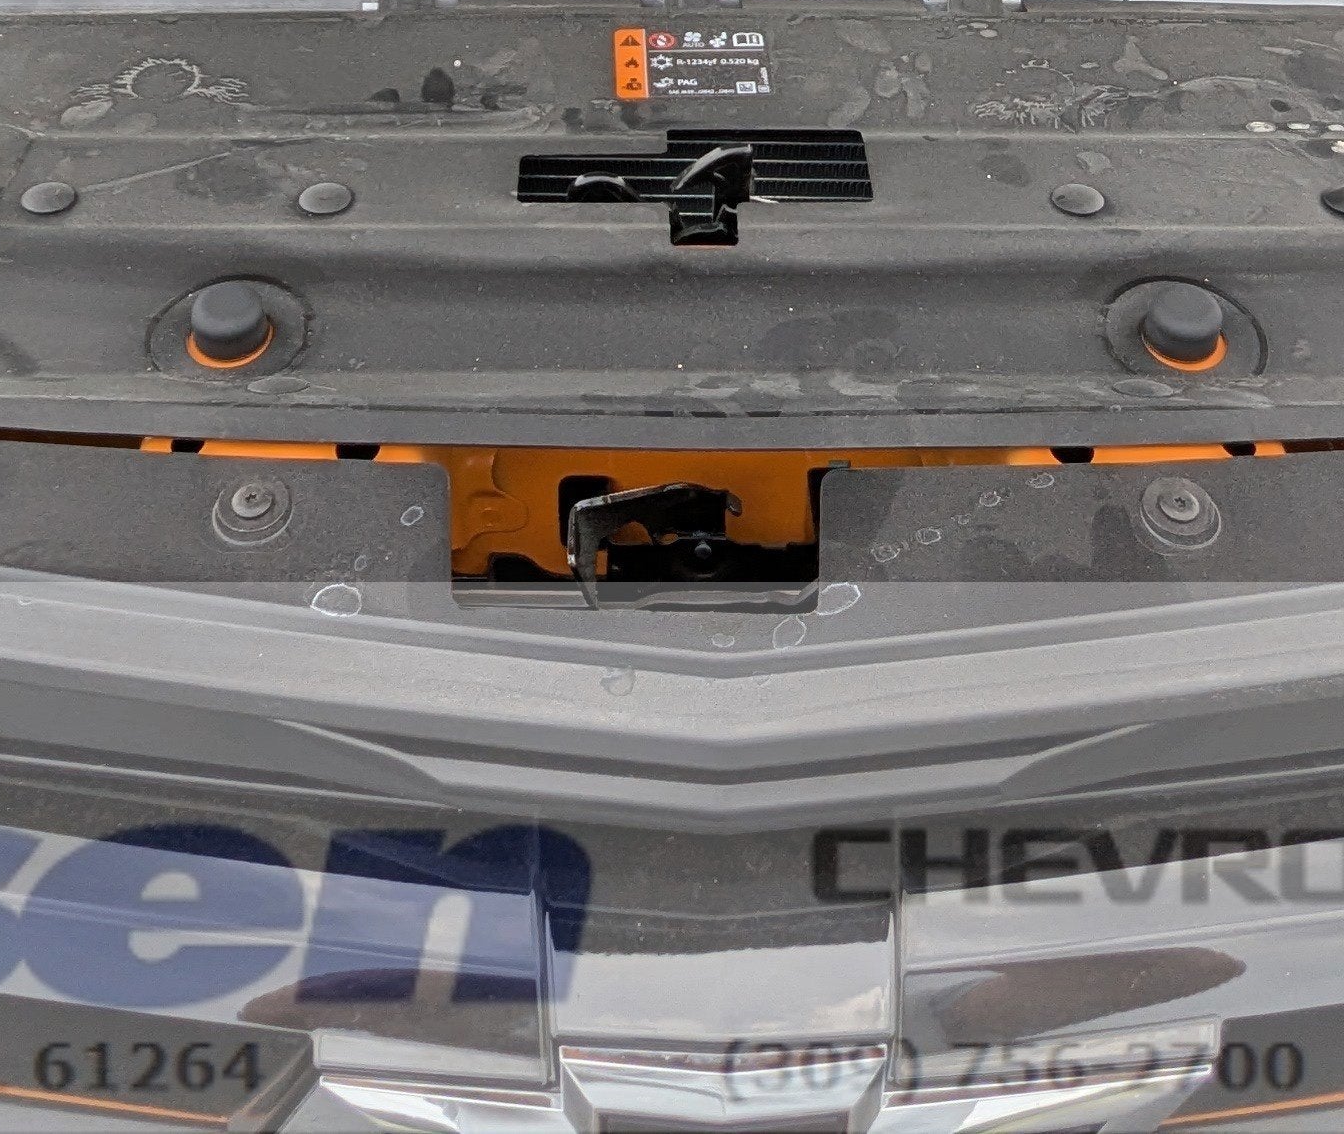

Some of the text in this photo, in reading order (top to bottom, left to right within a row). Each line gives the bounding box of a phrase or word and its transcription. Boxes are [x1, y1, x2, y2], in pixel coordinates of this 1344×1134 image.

[676, 58, 718, 66] R-1234yf
[747, 57, 760, 66] kg
[677, 78, 698, 86] PAG
